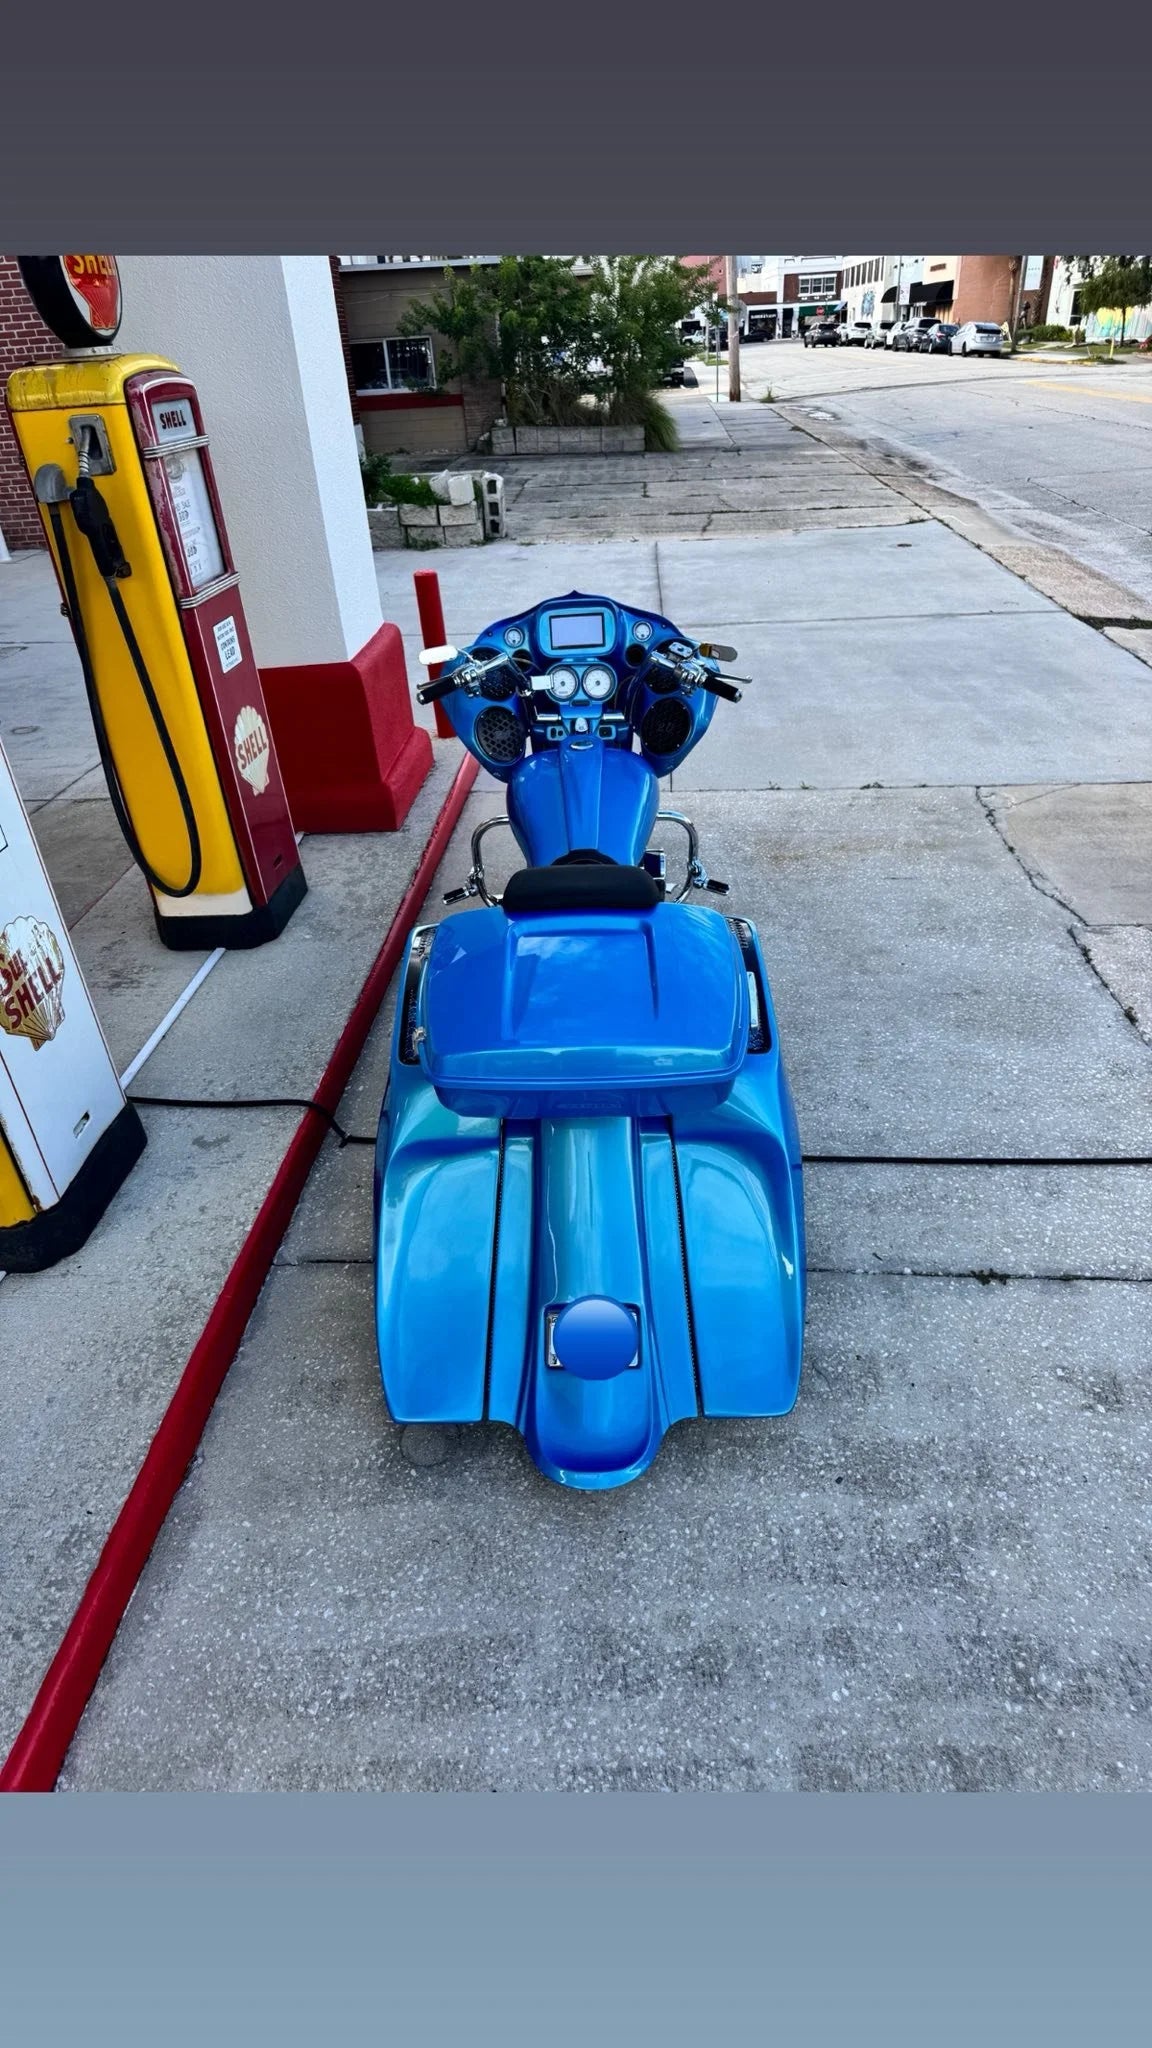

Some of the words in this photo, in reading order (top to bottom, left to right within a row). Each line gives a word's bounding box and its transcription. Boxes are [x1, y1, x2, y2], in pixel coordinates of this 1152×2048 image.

[160, 410, 187, 430] SHELL
[238, 726, 267, 770] SHELL
[5, 957, 61, 1029] SHELL
